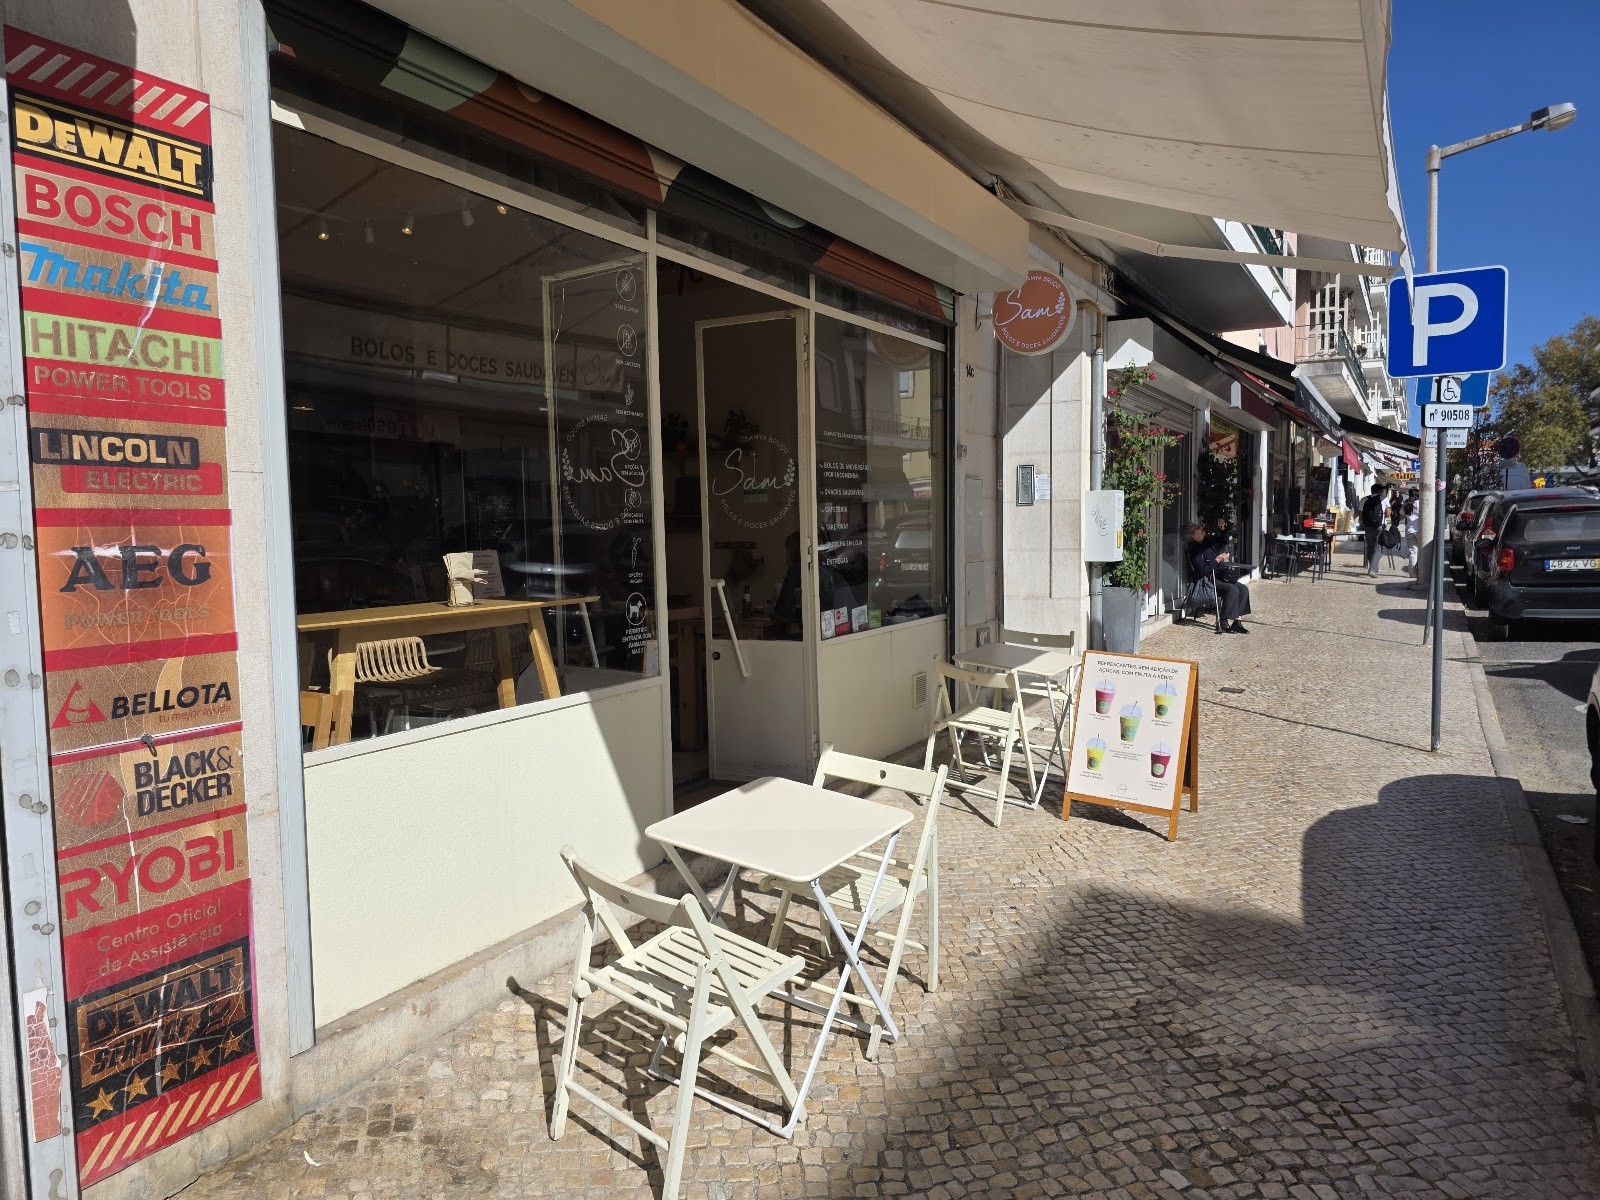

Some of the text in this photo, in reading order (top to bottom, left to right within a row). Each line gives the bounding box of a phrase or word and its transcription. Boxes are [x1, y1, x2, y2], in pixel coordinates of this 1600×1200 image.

[24, 174, 201, 251] BOSCH
[994, 289, 1057, 326] Sam
[1413, 283, 1479, 367] P
[28, 317, 213, 374] HITACHI
[351, 336, 415, 364] BOLOS
[427, 348, 438, 366] E
[449, 352, 498, 376] DOCES
[35, 366, 212, 401] POWER TOOLS
[1440, 409, 1470, 422] 90508
[40, 432, 191, 465] LINCOLN
[85, 469, 202, 492] ELECTRIC
[712, 448, 786, 496] Sam
[60, 543, 212, 592] AEG
[65, 604, 209, 630] POWER TOOLS
[111, 682, 232, 720] BELLOTA
[172, 708, 199, 721] mejor
[203, 704, 232, 717] ayuda
[135, 773, 233, 817] DECKER
[97, 897, 222, 952] Centro Oficial
[98, 924, 223, 976] de Assistência
[87, 960, 235, 1044] DEWALT
